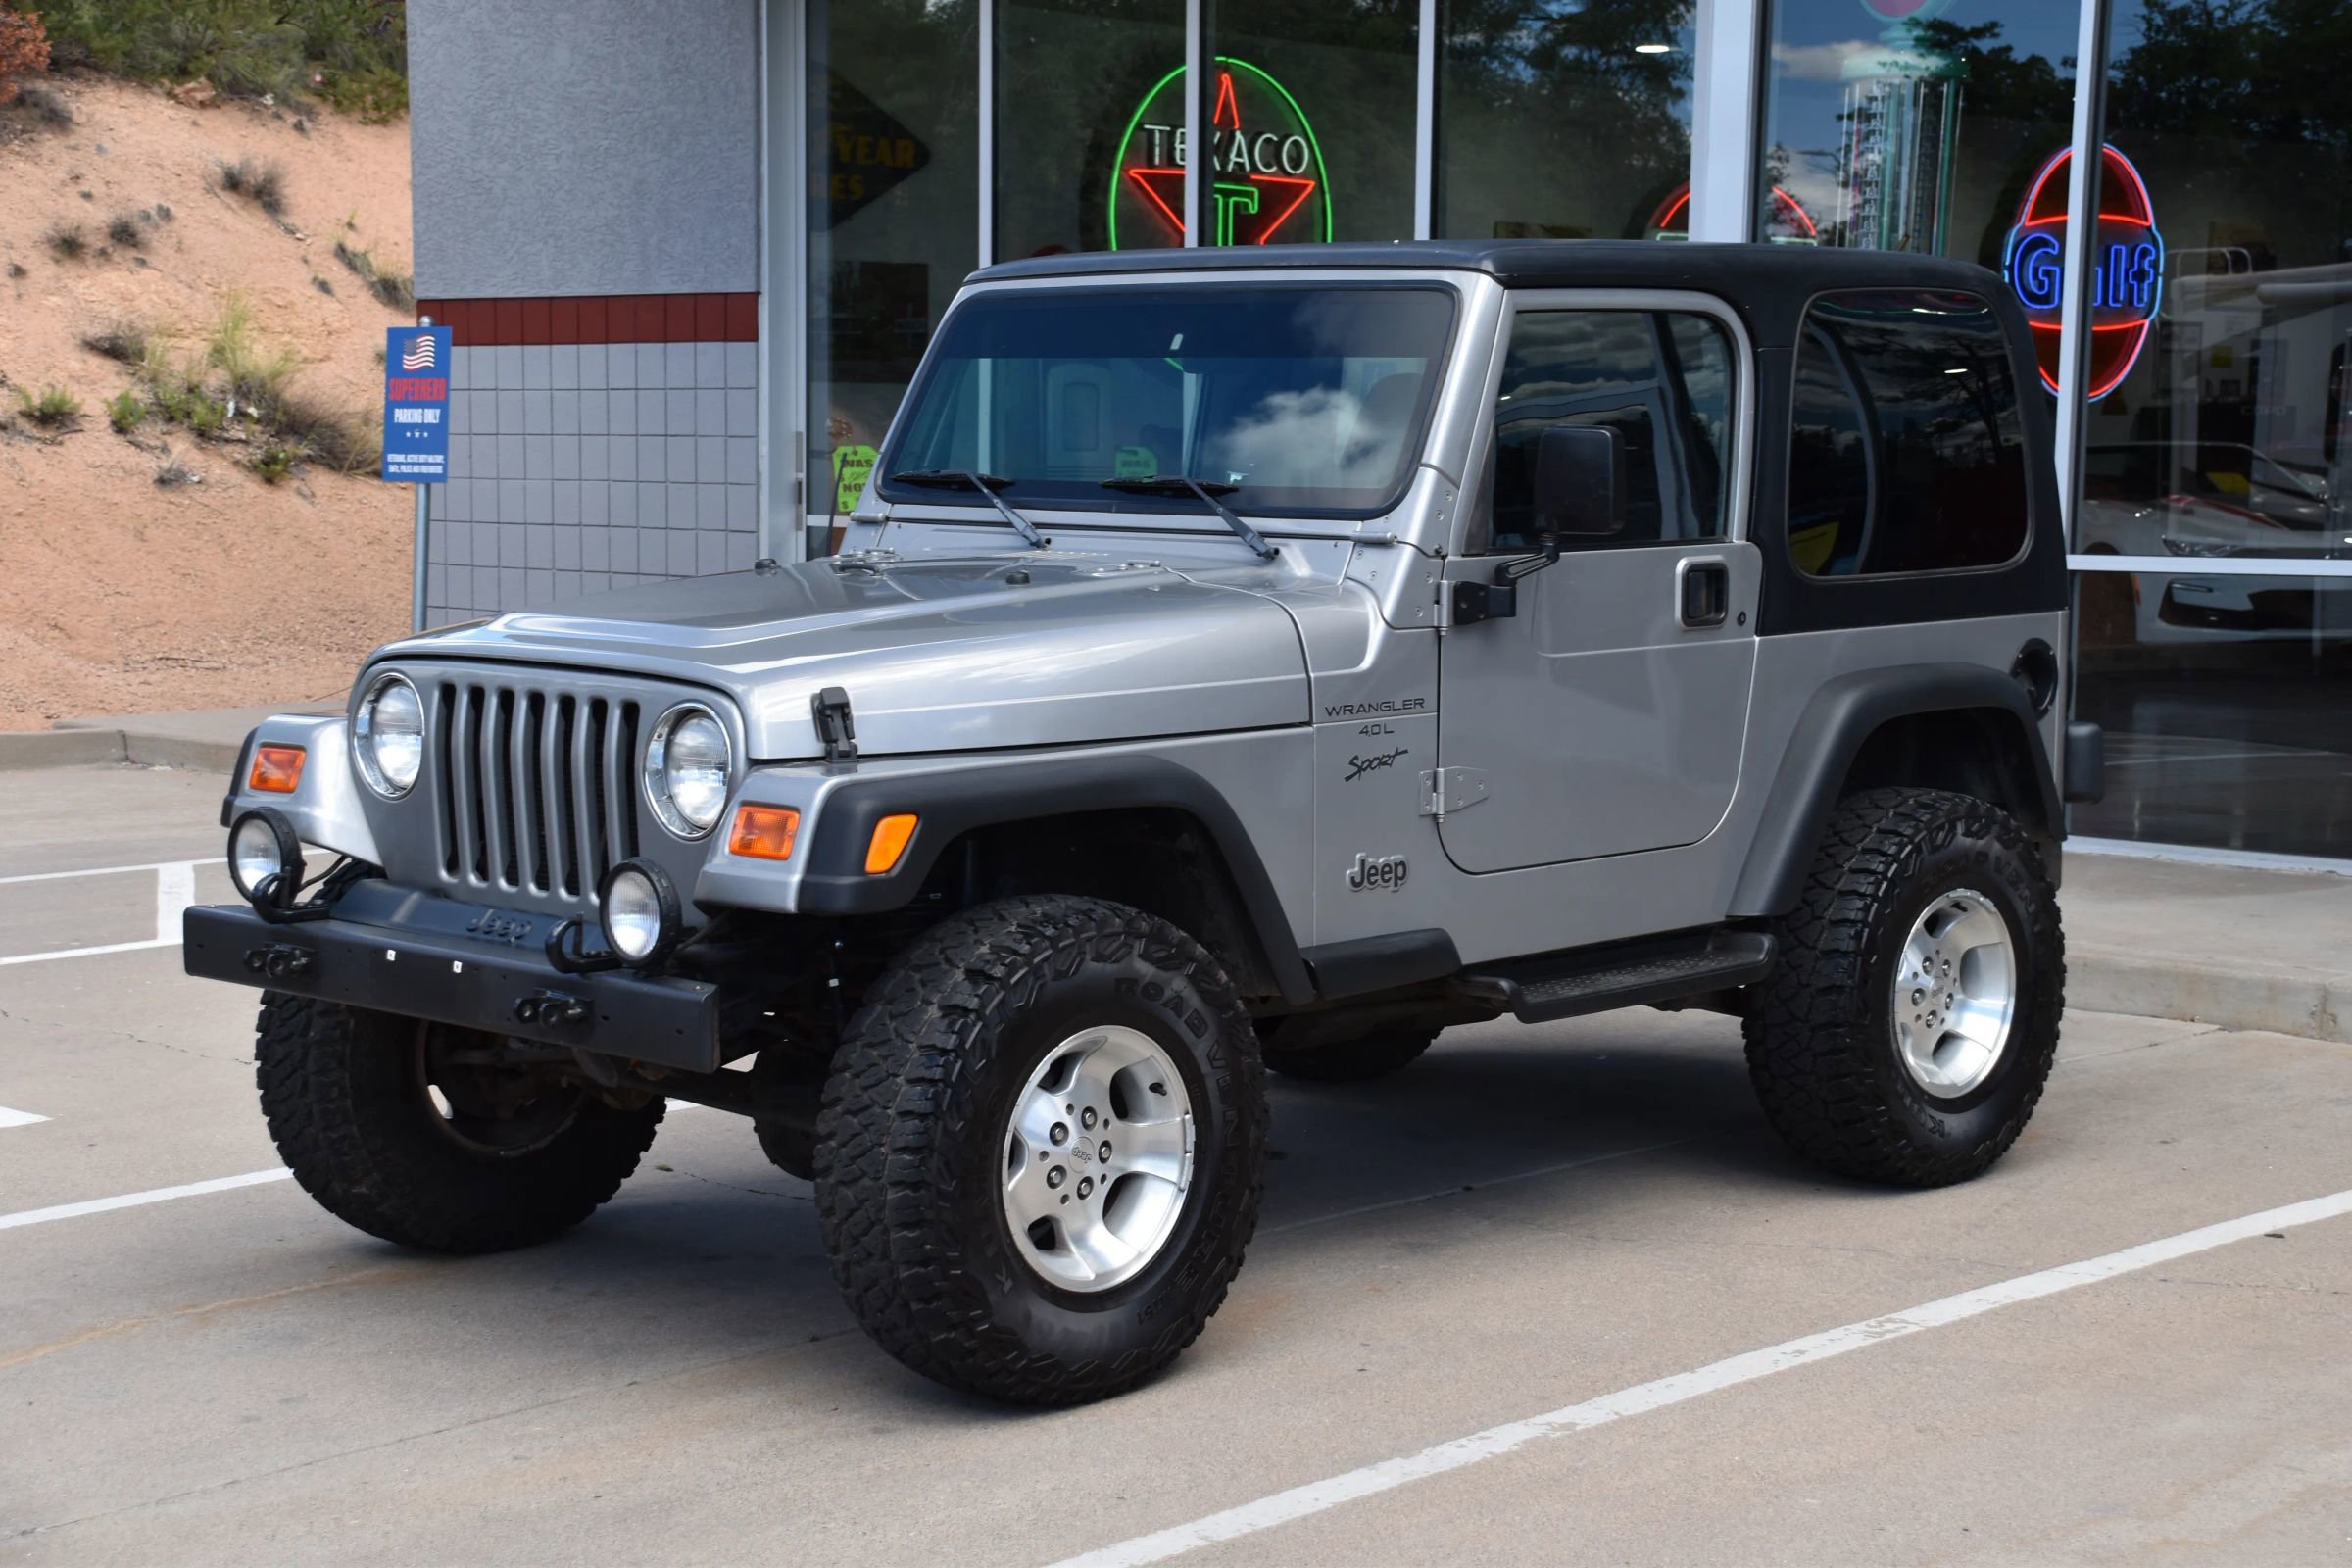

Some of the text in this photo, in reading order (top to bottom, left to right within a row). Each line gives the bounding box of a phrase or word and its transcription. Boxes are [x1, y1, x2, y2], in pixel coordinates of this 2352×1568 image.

[2014, 232, 2156, 309] Glf
[394, 408, 441, 424] PARKING ONLY
[843, 482, 865, 493] NO
[1325, 698, 1425, 717] WRANGLER
[1348, 854, 1408, 891] Jeep
[466, 909, 533, 942] Jeep
[1114, 977, 1207, 1039] ROAD
